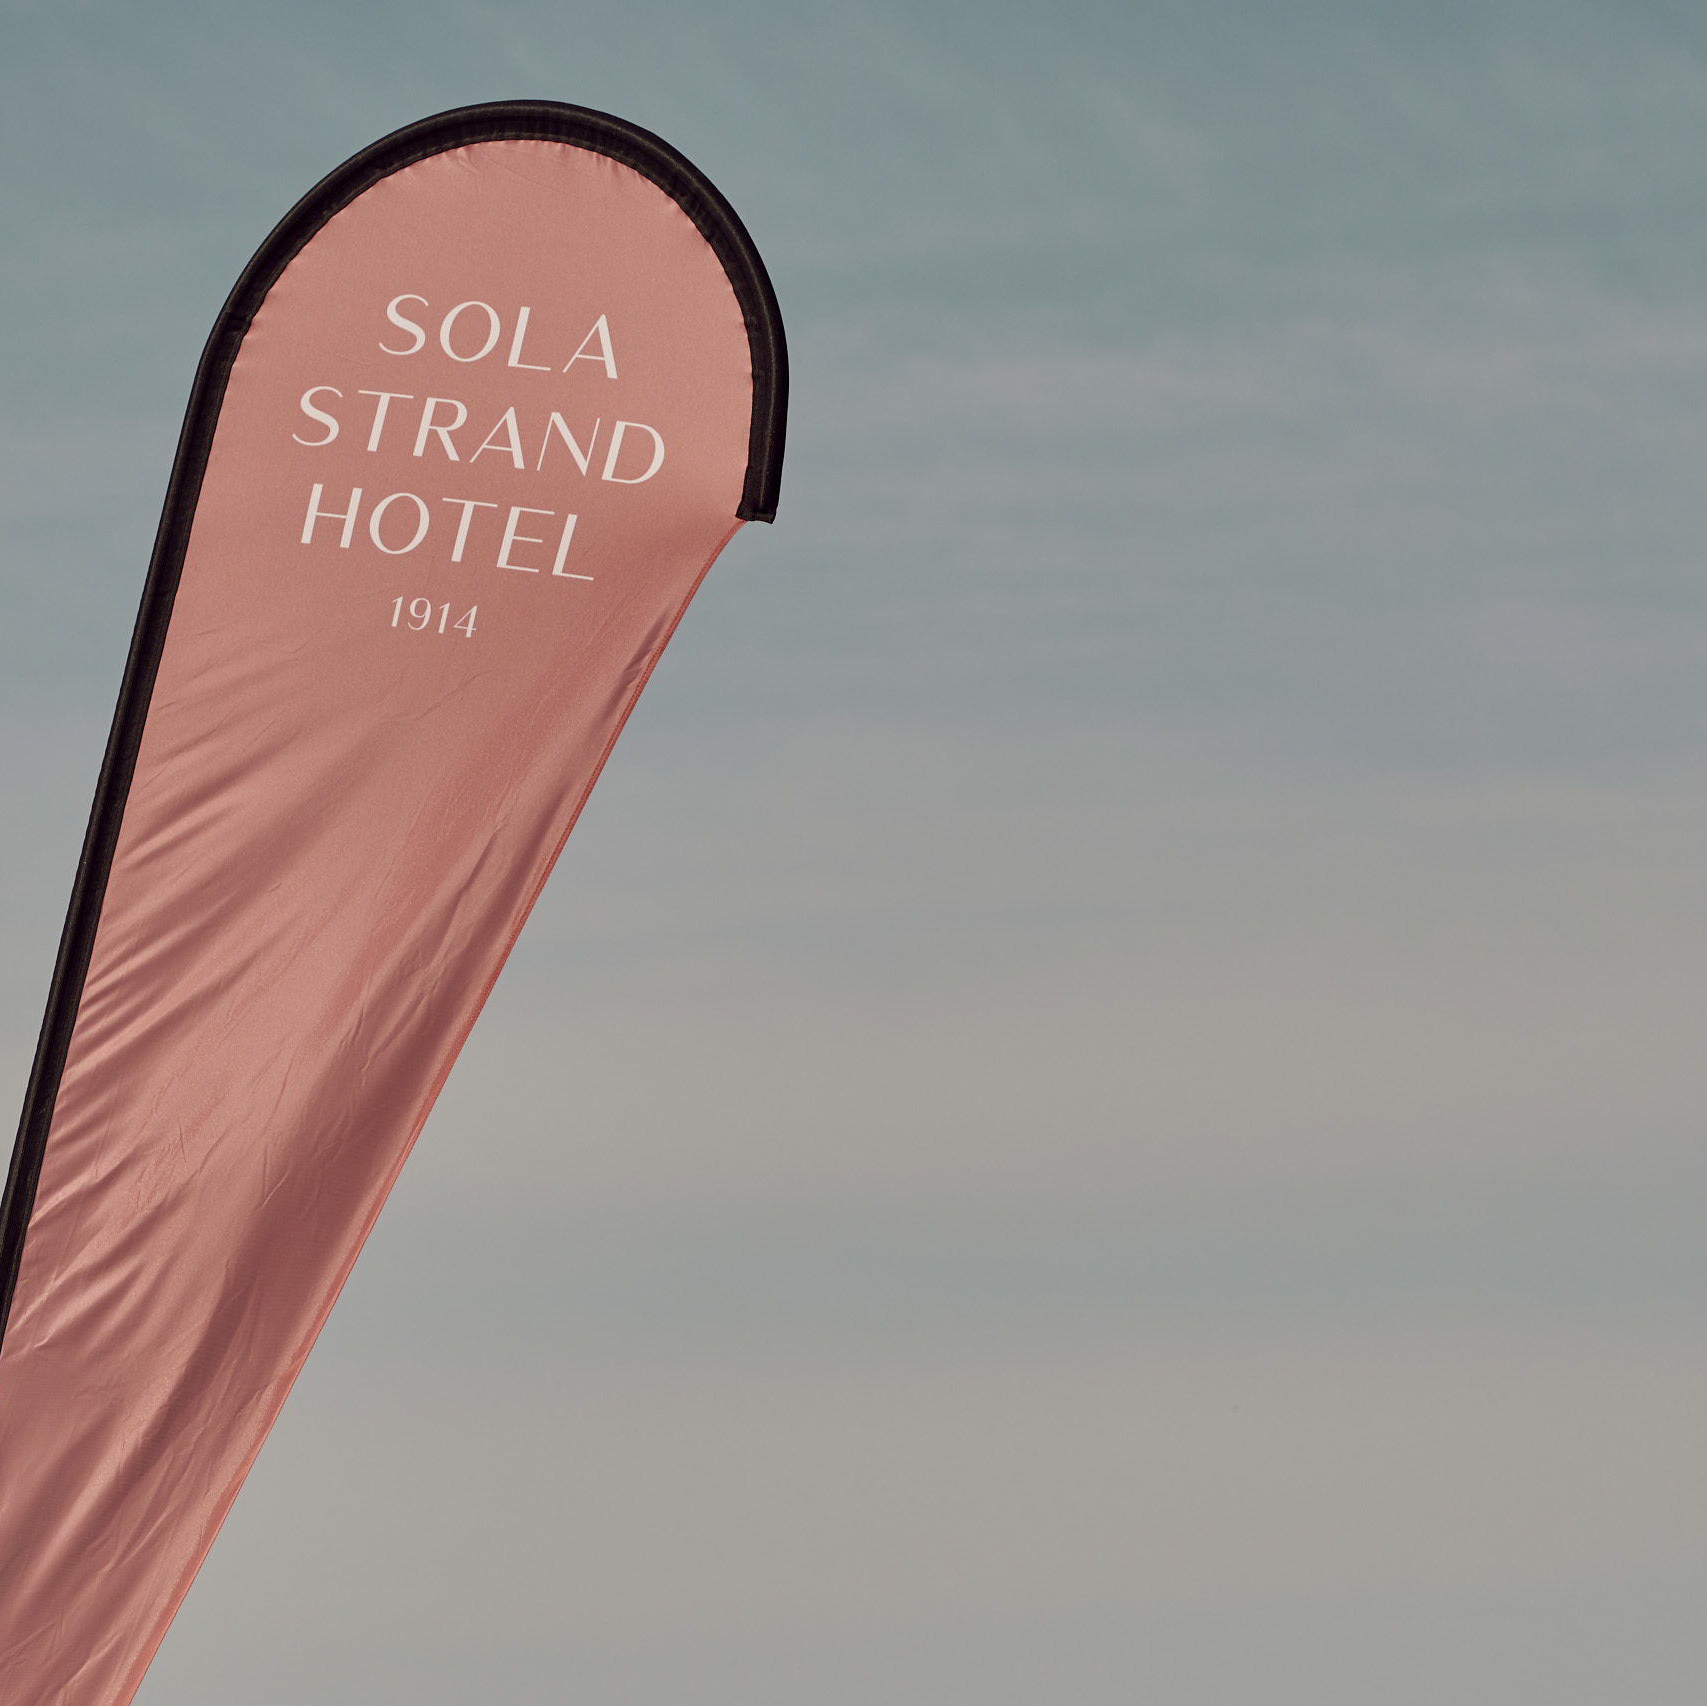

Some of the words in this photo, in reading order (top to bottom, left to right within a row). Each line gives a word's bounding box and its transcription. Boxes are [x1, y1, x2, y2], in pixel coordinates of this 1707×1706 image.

[378, 294, 618, 380] SOLA
[292, 386, 665, 484] STRAND
[300, 483, 594, 581] HOTEL
[391, 596, 478, 638] 1914
